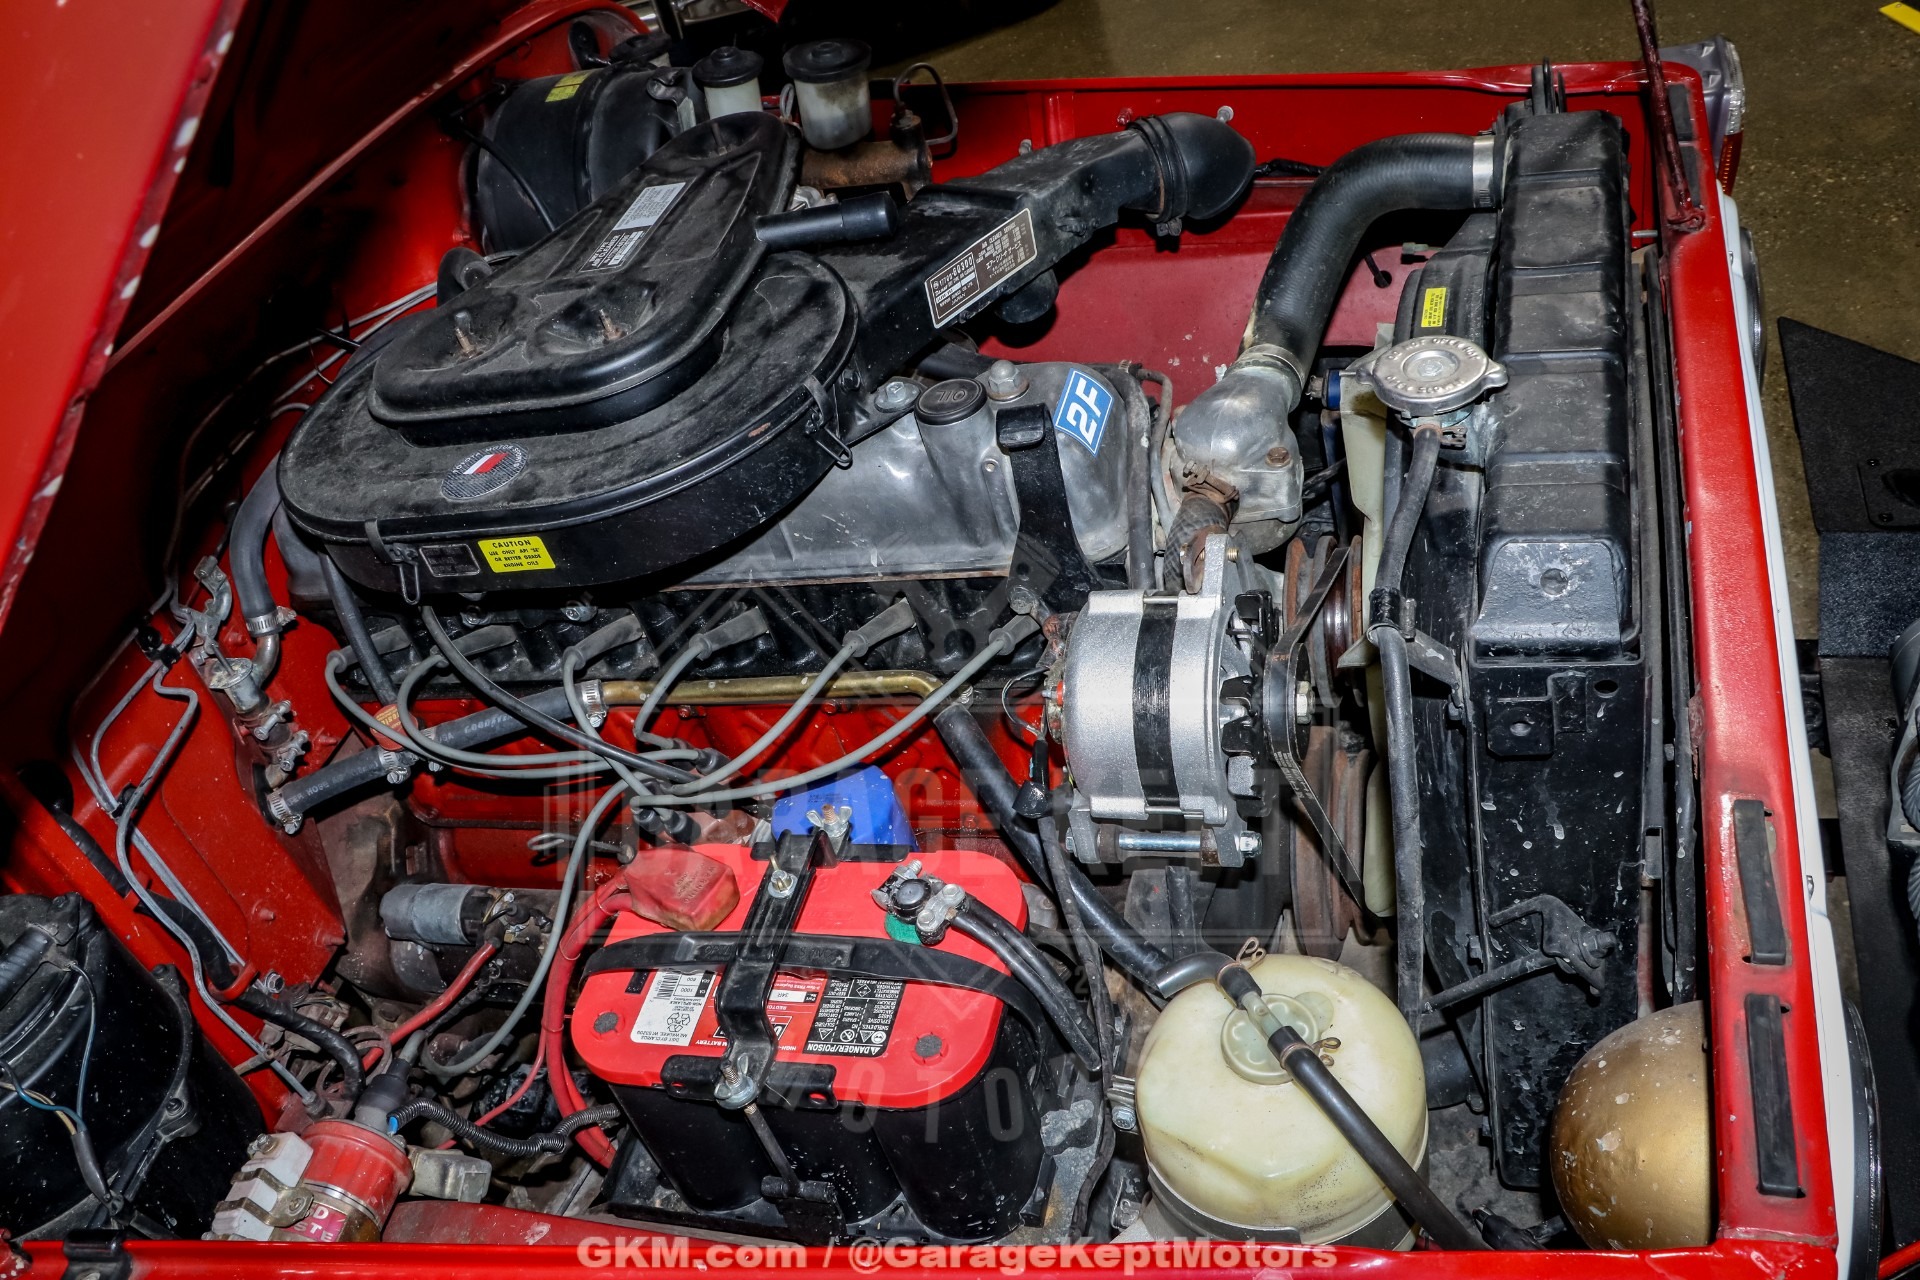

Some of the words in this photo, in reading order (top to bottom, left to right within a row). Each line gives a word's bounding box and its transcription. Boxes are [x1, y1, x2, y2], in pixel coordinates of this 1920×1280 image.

[1066, 377, 1101, 445] 2F
[492, 540, 531, 548] CAUTION
[807, 1043, 870, 1054] DANGER/POISON
